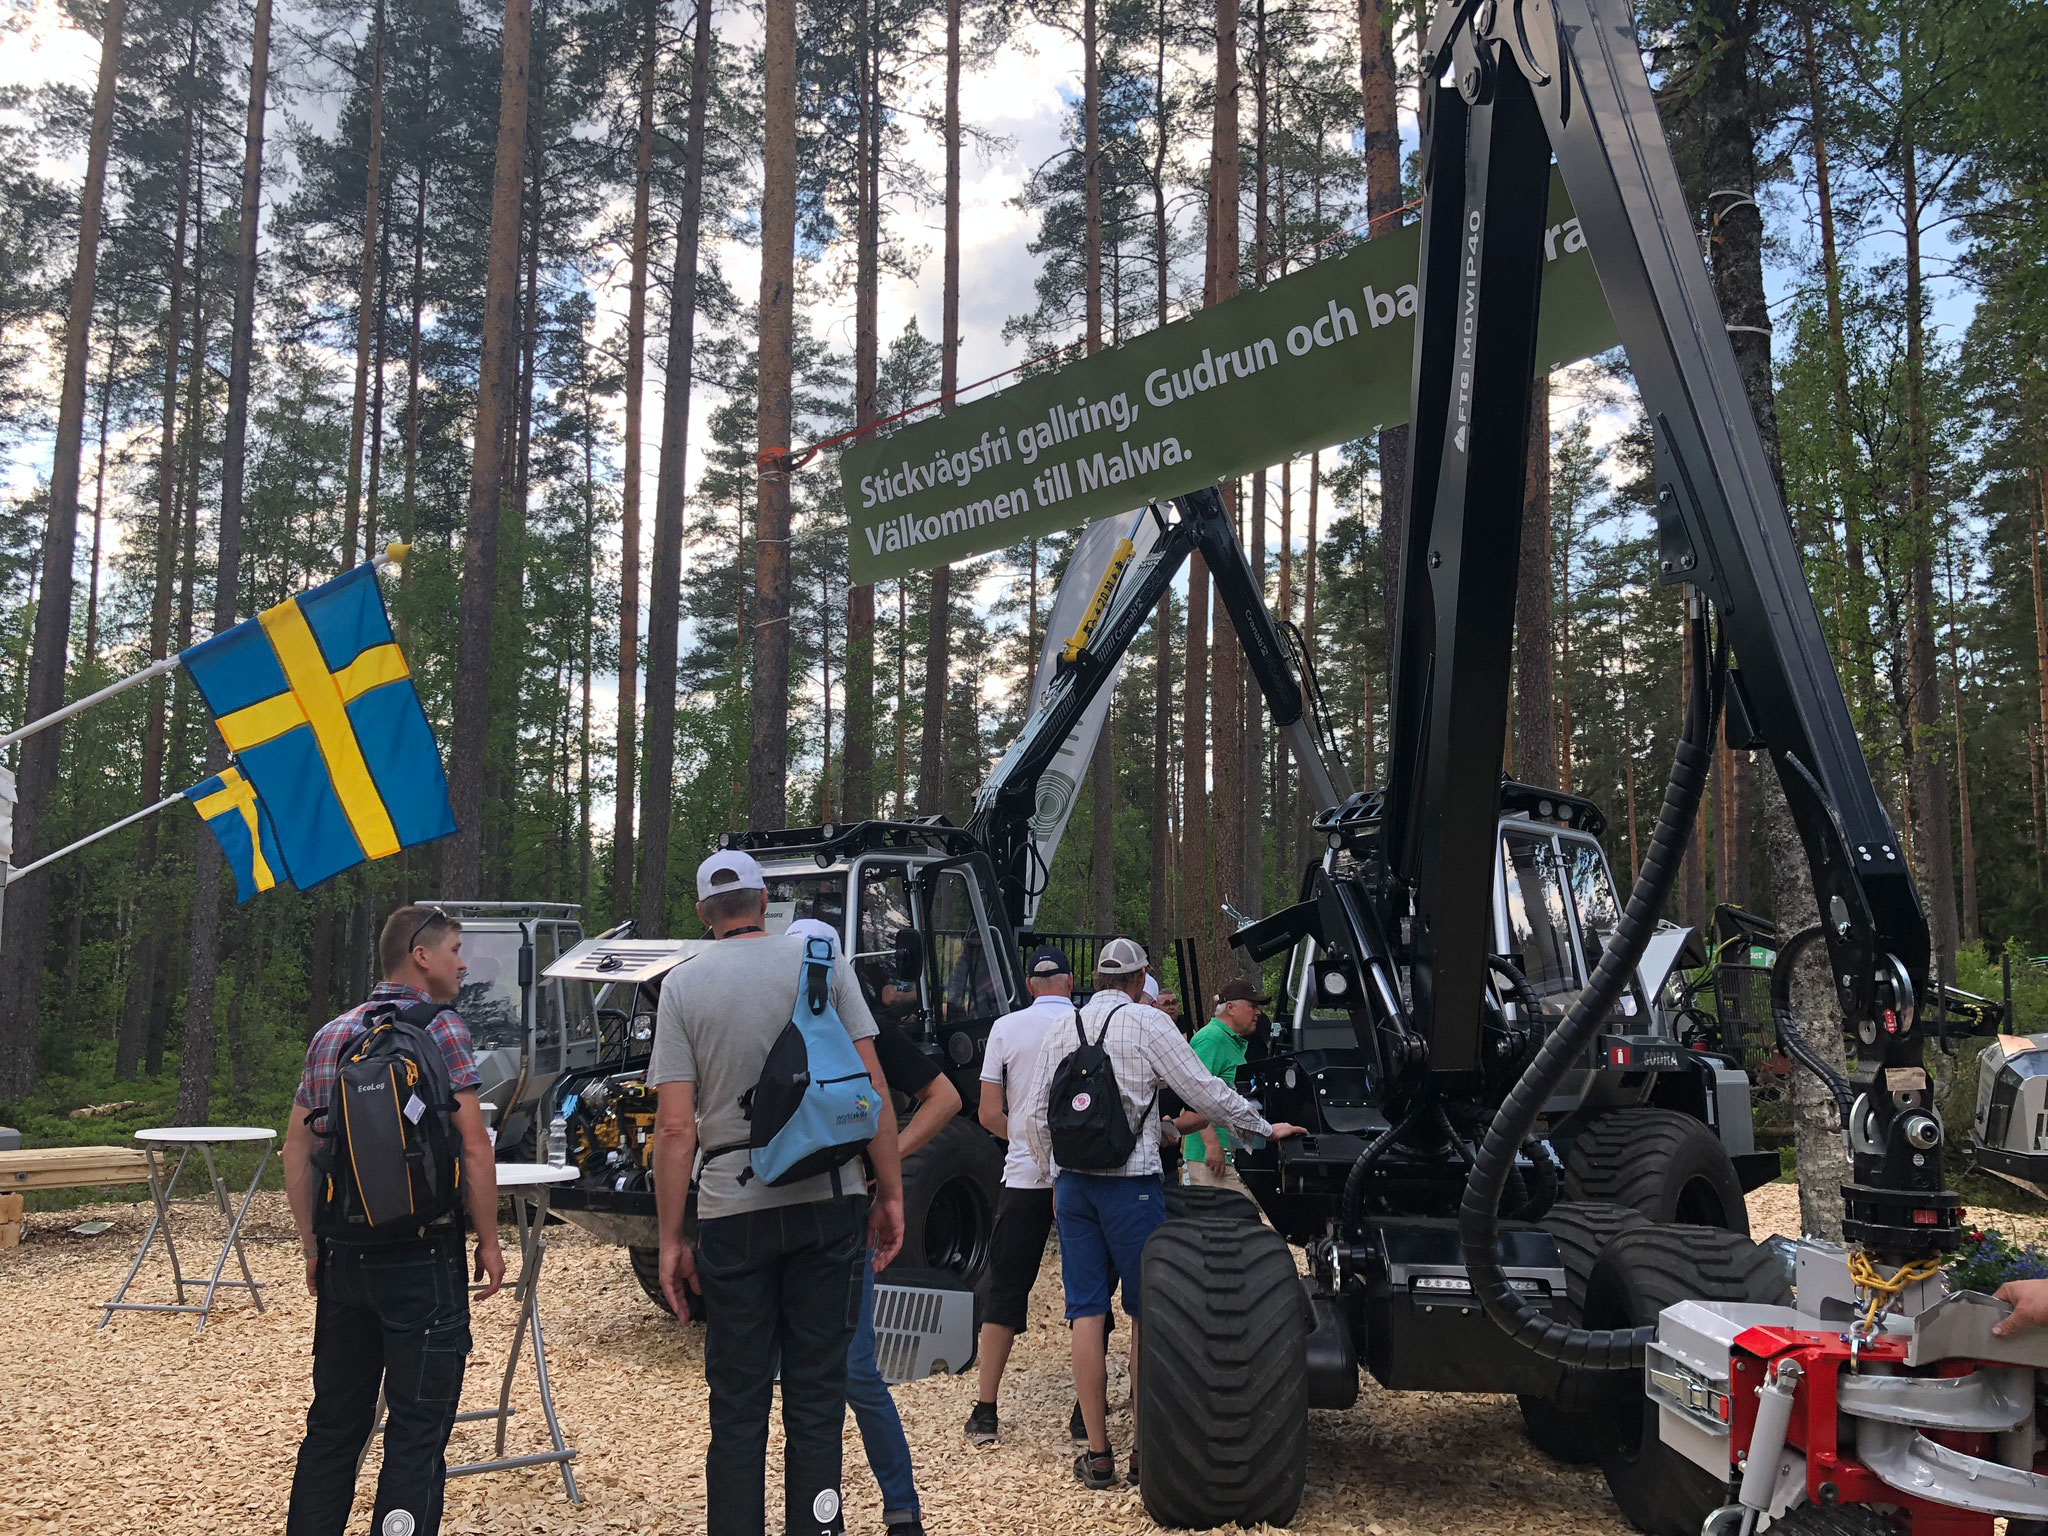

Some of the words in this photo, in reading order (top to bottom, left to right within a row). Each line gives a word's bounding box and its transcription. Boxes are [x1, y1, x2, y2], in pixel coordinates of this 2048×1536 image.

[860, 425, 1013, 509] Stickvägsfri
[1016, 391, 1140, 465] gallring,
[1144, 337, 1279, 407] Gudrun
[1286, 299, 1359, 357] och
[1458, 371, 1469, 422] FTG
[865, 486, 1030, 557] Välkommen
[1033, 462, 1073, 507] till
[1076, 437, 1193, 494] Malwa.
[1115, 607, 1139, 641] Cranab
[1245, 608, 1266, 649] Cranab
[357, 1082, 386, 1093] EcoLog
